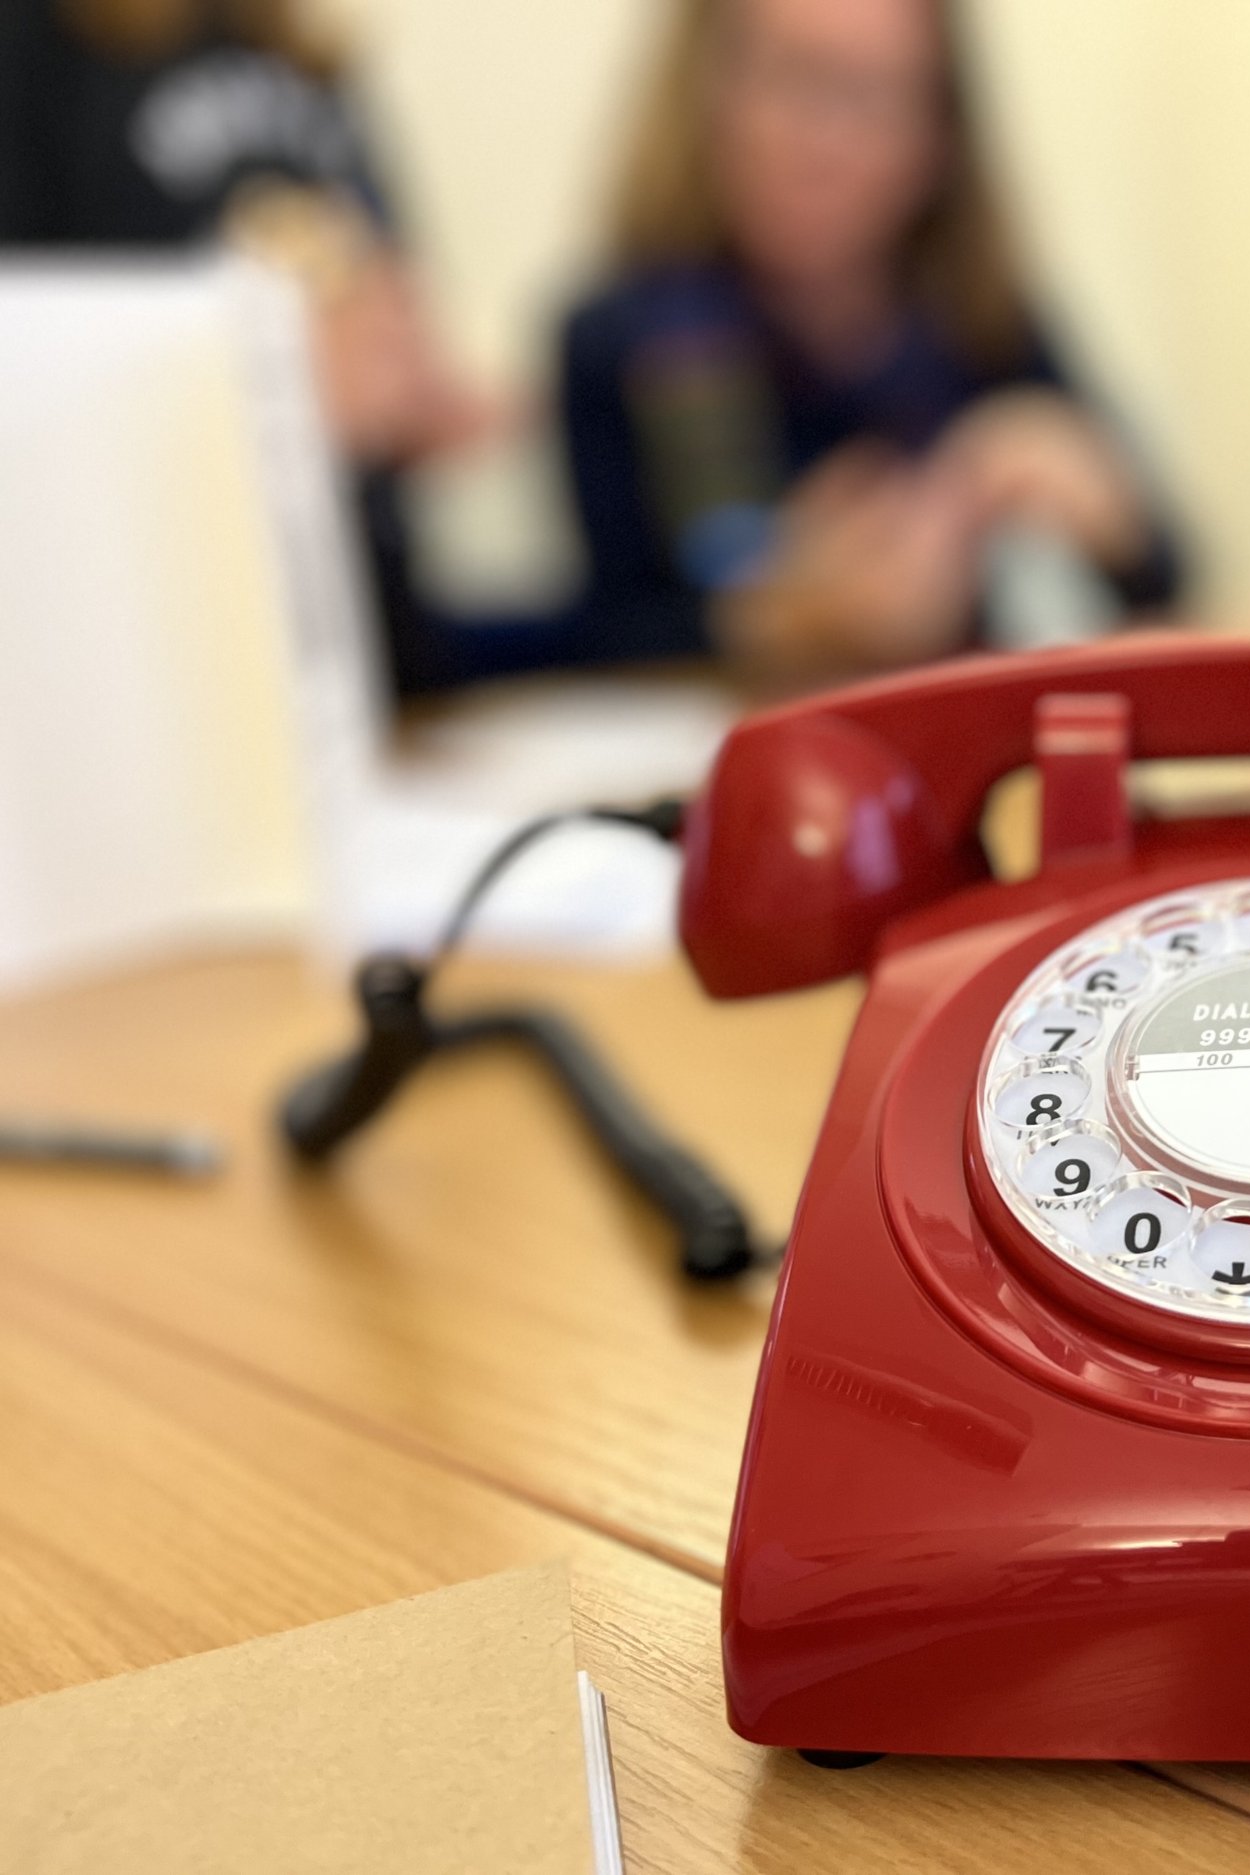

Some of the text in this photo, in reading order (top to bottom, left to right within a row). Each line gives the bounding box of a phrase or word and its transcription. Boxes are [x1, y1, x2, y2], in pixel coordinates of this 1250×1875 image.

[1085, 969, 1118, 992] 6
[1042, 1027, 1077, 1053] 7
[1197, 1052, 1234, 1067] 100
[1025, 1093, 1063, 1127] 8
[1053, 1158, 1092, 1197] 9
